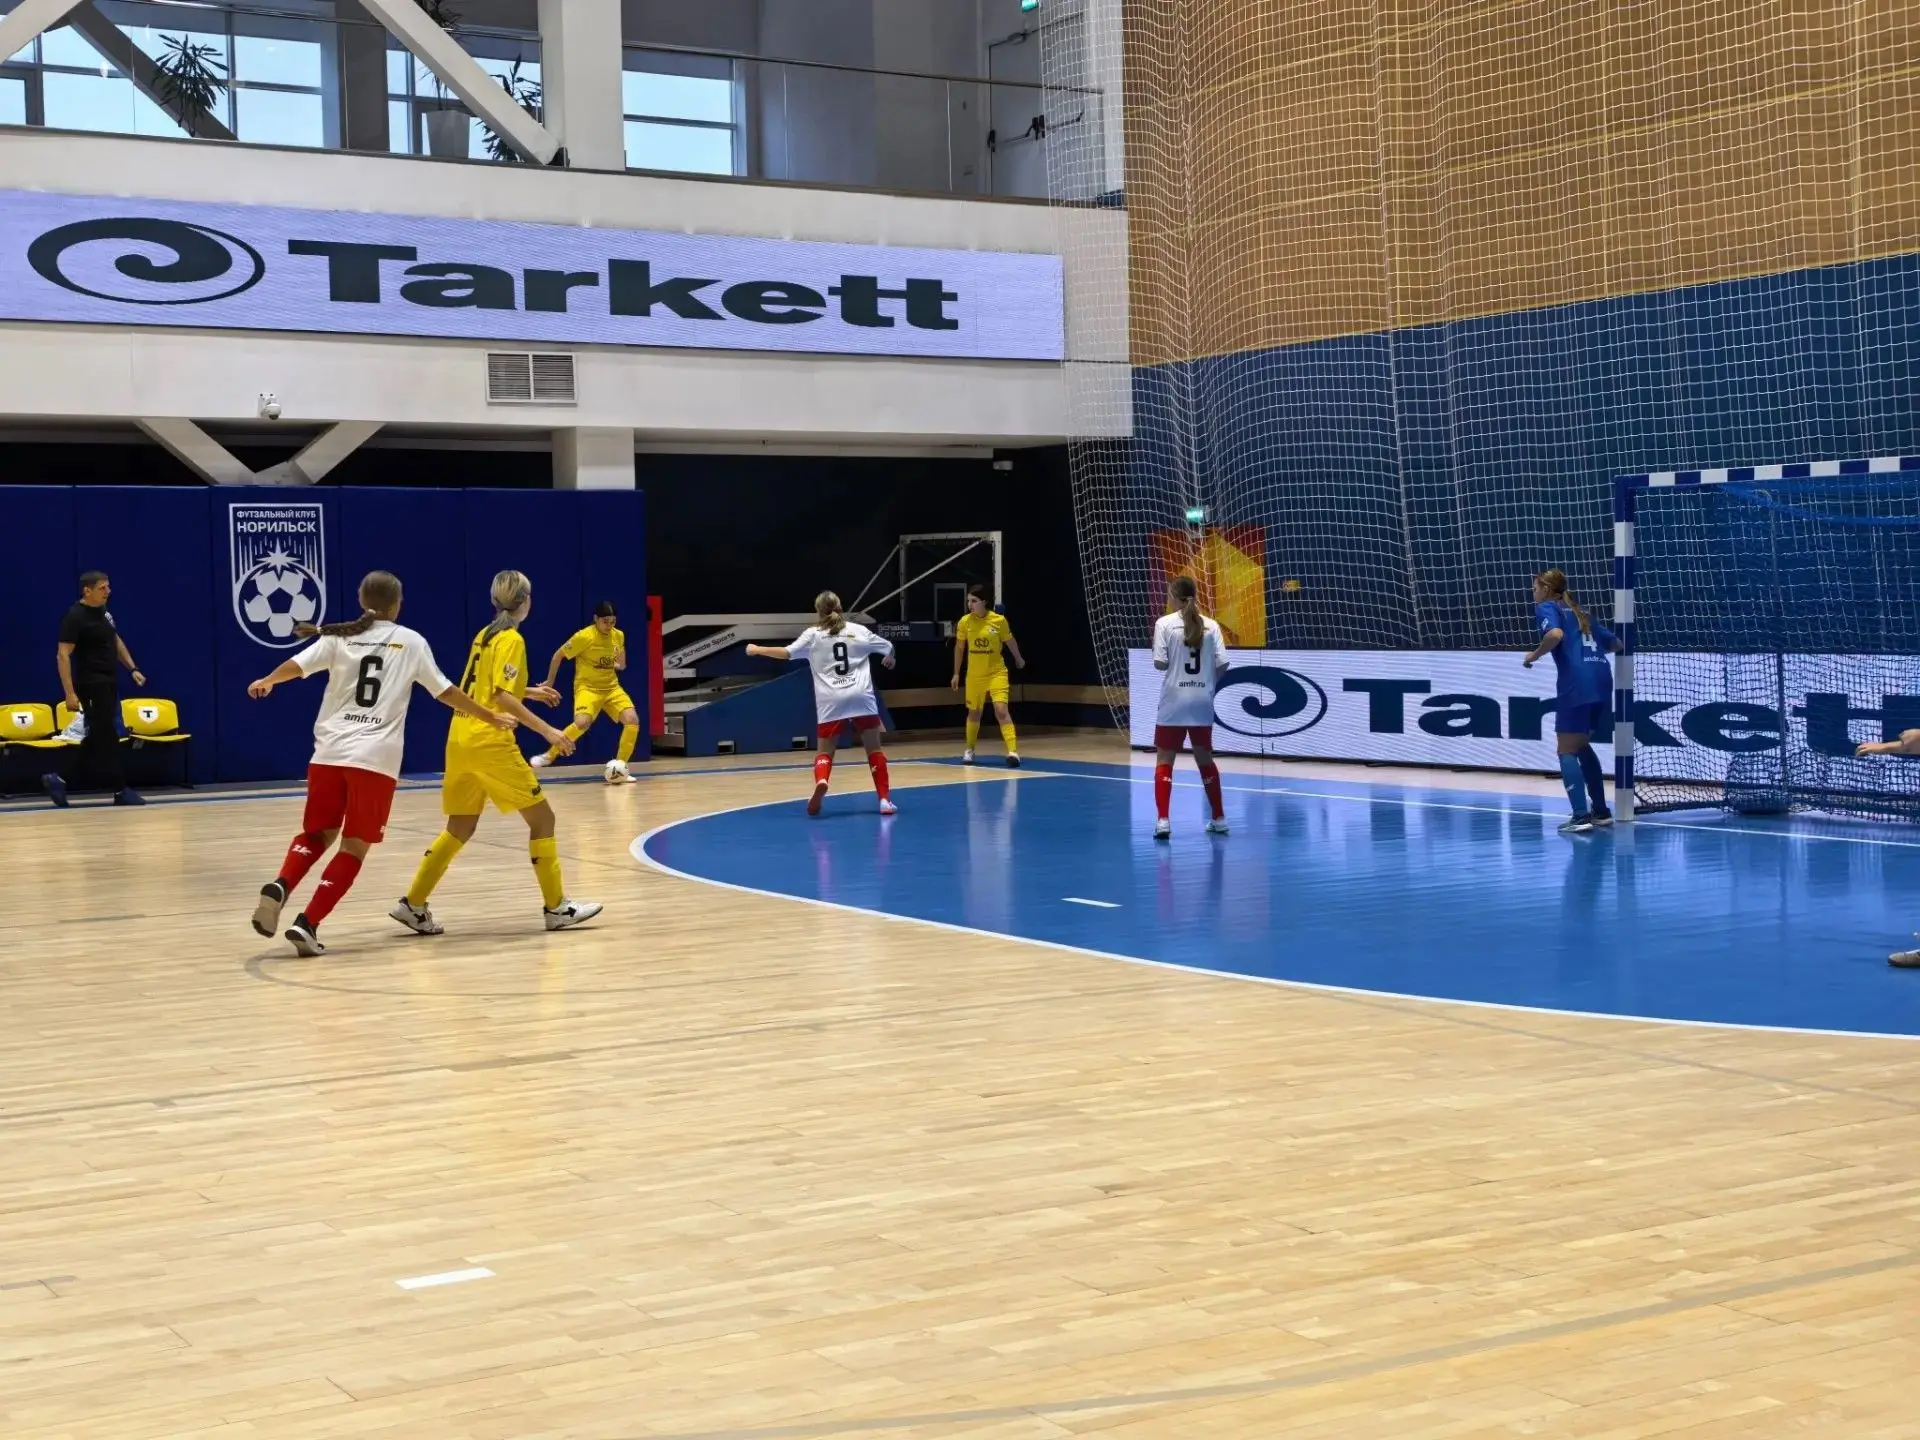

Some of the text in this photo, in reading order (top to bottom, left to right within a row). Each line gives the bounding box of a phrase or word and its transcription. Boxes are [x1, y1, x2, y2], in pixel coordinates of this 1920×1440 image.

[288, 239, 958, 330] Tarkett
[237, 510, 316, 518] ФУТЗАЛЬНЫЙ КЛУБ
[237, 521, 316, 533] НОРИЛЬСК
[1582, 633, 1597, 652] 4
[833, 642, 849, 676] 9
[1184, 640, 1201, 675] 3
[355, 655, 384, 708] 6
[18, 716, 28, 724] T
[143, 710, 153, 718] T
[344, 713, 382, 724] amfr.ru
